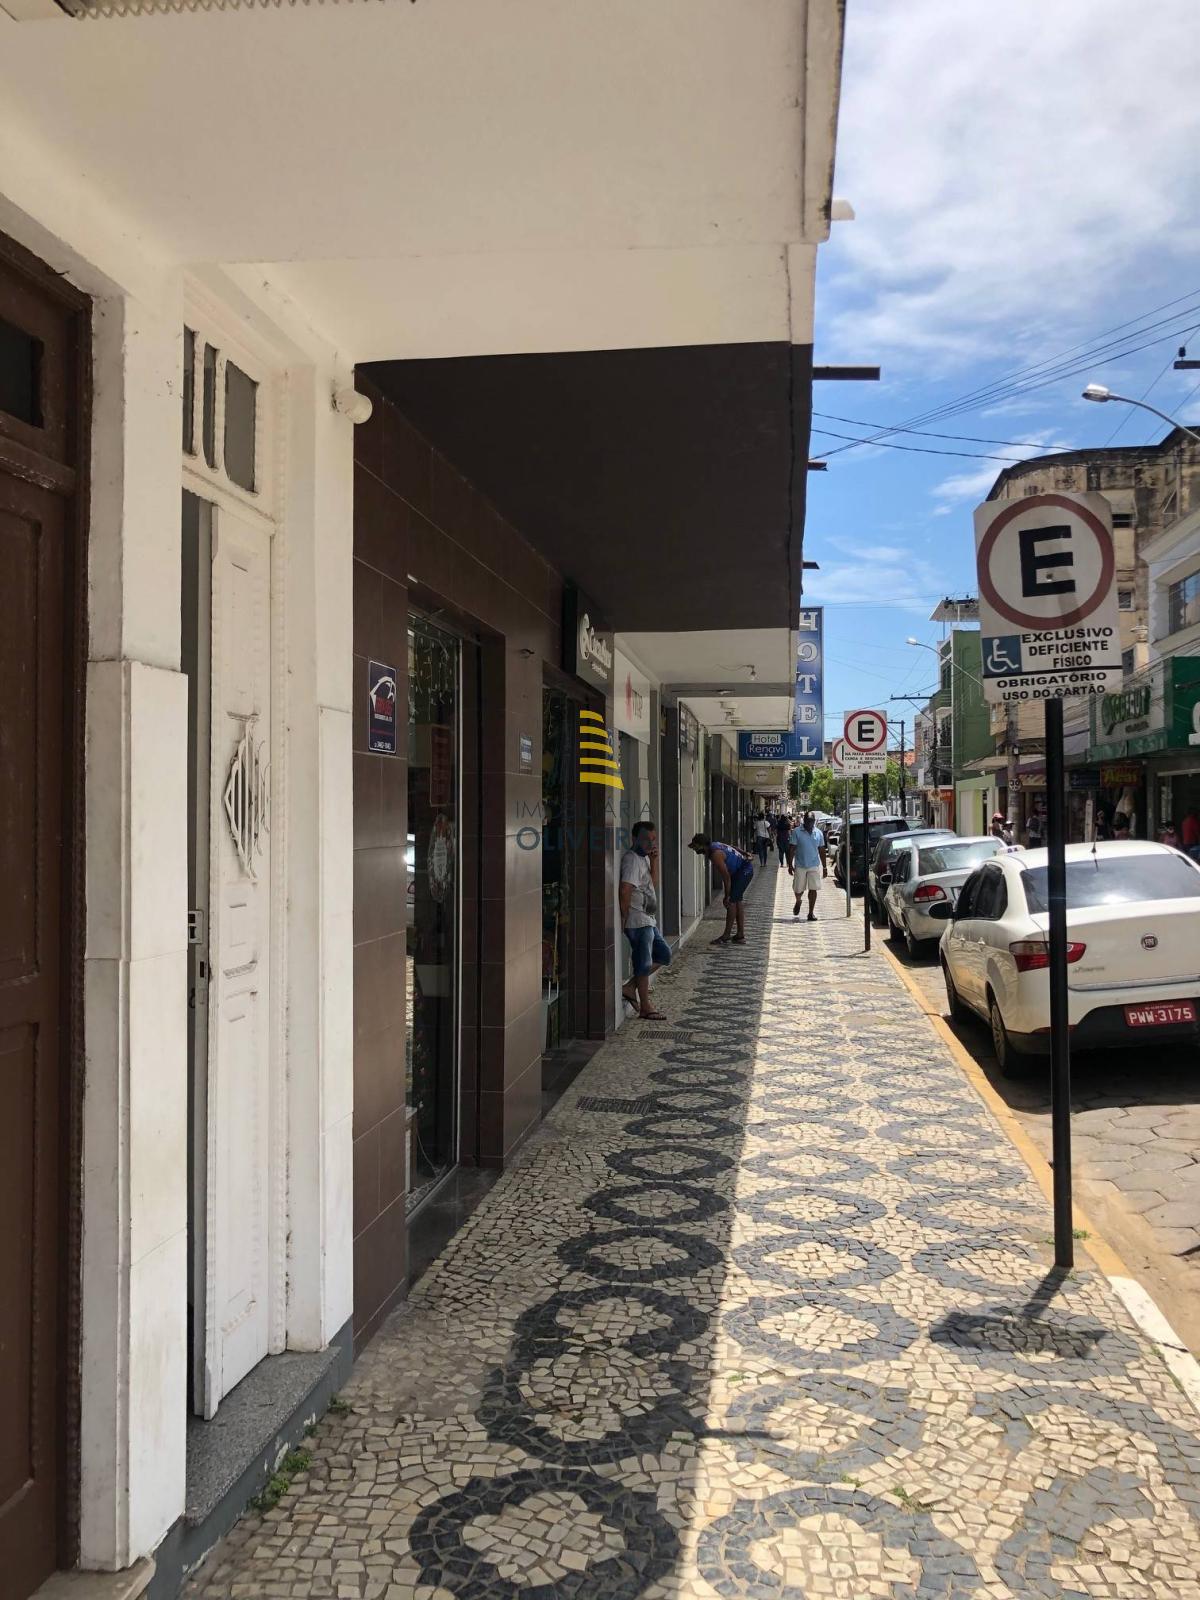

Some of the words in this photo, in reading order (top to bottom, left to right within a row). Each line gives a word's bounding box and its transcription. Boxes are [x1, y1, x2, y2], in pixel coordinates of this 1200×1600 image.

[1018, 524, 1076, 598] E
[1021, 627, 1113, 644] EXCLUSIVO
[1028, 640, 1109, 657] DEFICIENTE
[1052, 654, 1092, 668] FÍSICO
[798, 611, 819, 756] HOTEL
[996, 671, 1107, 689] OBRIGATÓRIO
[1002, 690, 1029, 701] USO
[1032, 689, 1051, 699] DO
[1054, 684, 1106, 697] CARTÃO
[753, 735, 779, 743] Hotel
[857, 720, 875, 742] E
[749, 744, 784, 753] Renavi
